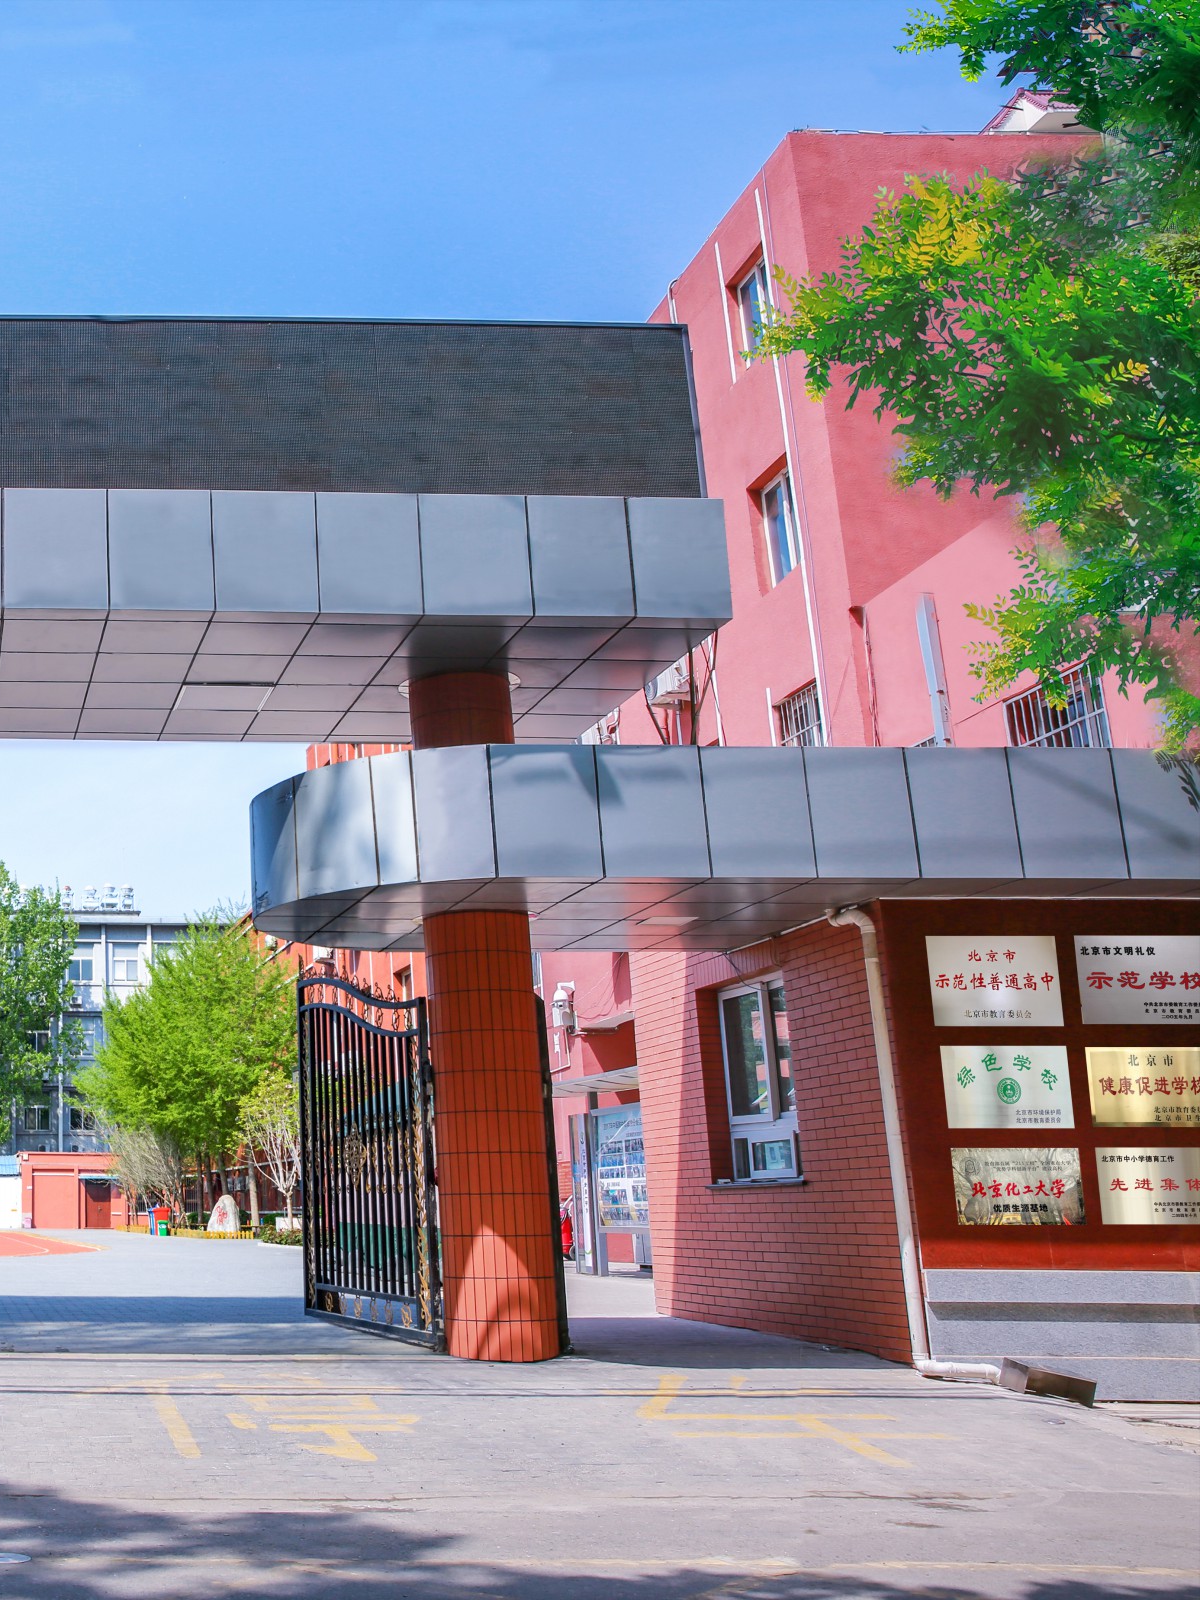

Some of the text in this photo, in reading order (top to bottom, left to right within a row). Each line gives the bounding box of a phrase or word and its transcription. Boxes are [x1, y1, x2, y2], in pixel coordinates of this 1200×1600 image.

[968, 949, 1017, 963] 北京市
[1080, 946, 1156, 956] 北京市文明礼仪
[935, 972, 1054, 991] 示范性普通高中
[1086, 971, 1200, 990] 示范学校
[964, 1009, 1032, 1019] 北京市教育委员会
[1128, 1054, 1174, 1067] 北京市
[957, 1053, 1058, 1091] 绿色学校
[1101, 1155, 1175, 1163] 北京市中小学德育工作
[972, 1179, 1066, 1198] 北京化工大学
[1109, 1178, 1200, 1191] 先进集体
[993, 1204, 1048, 1213] 优质生源基地
